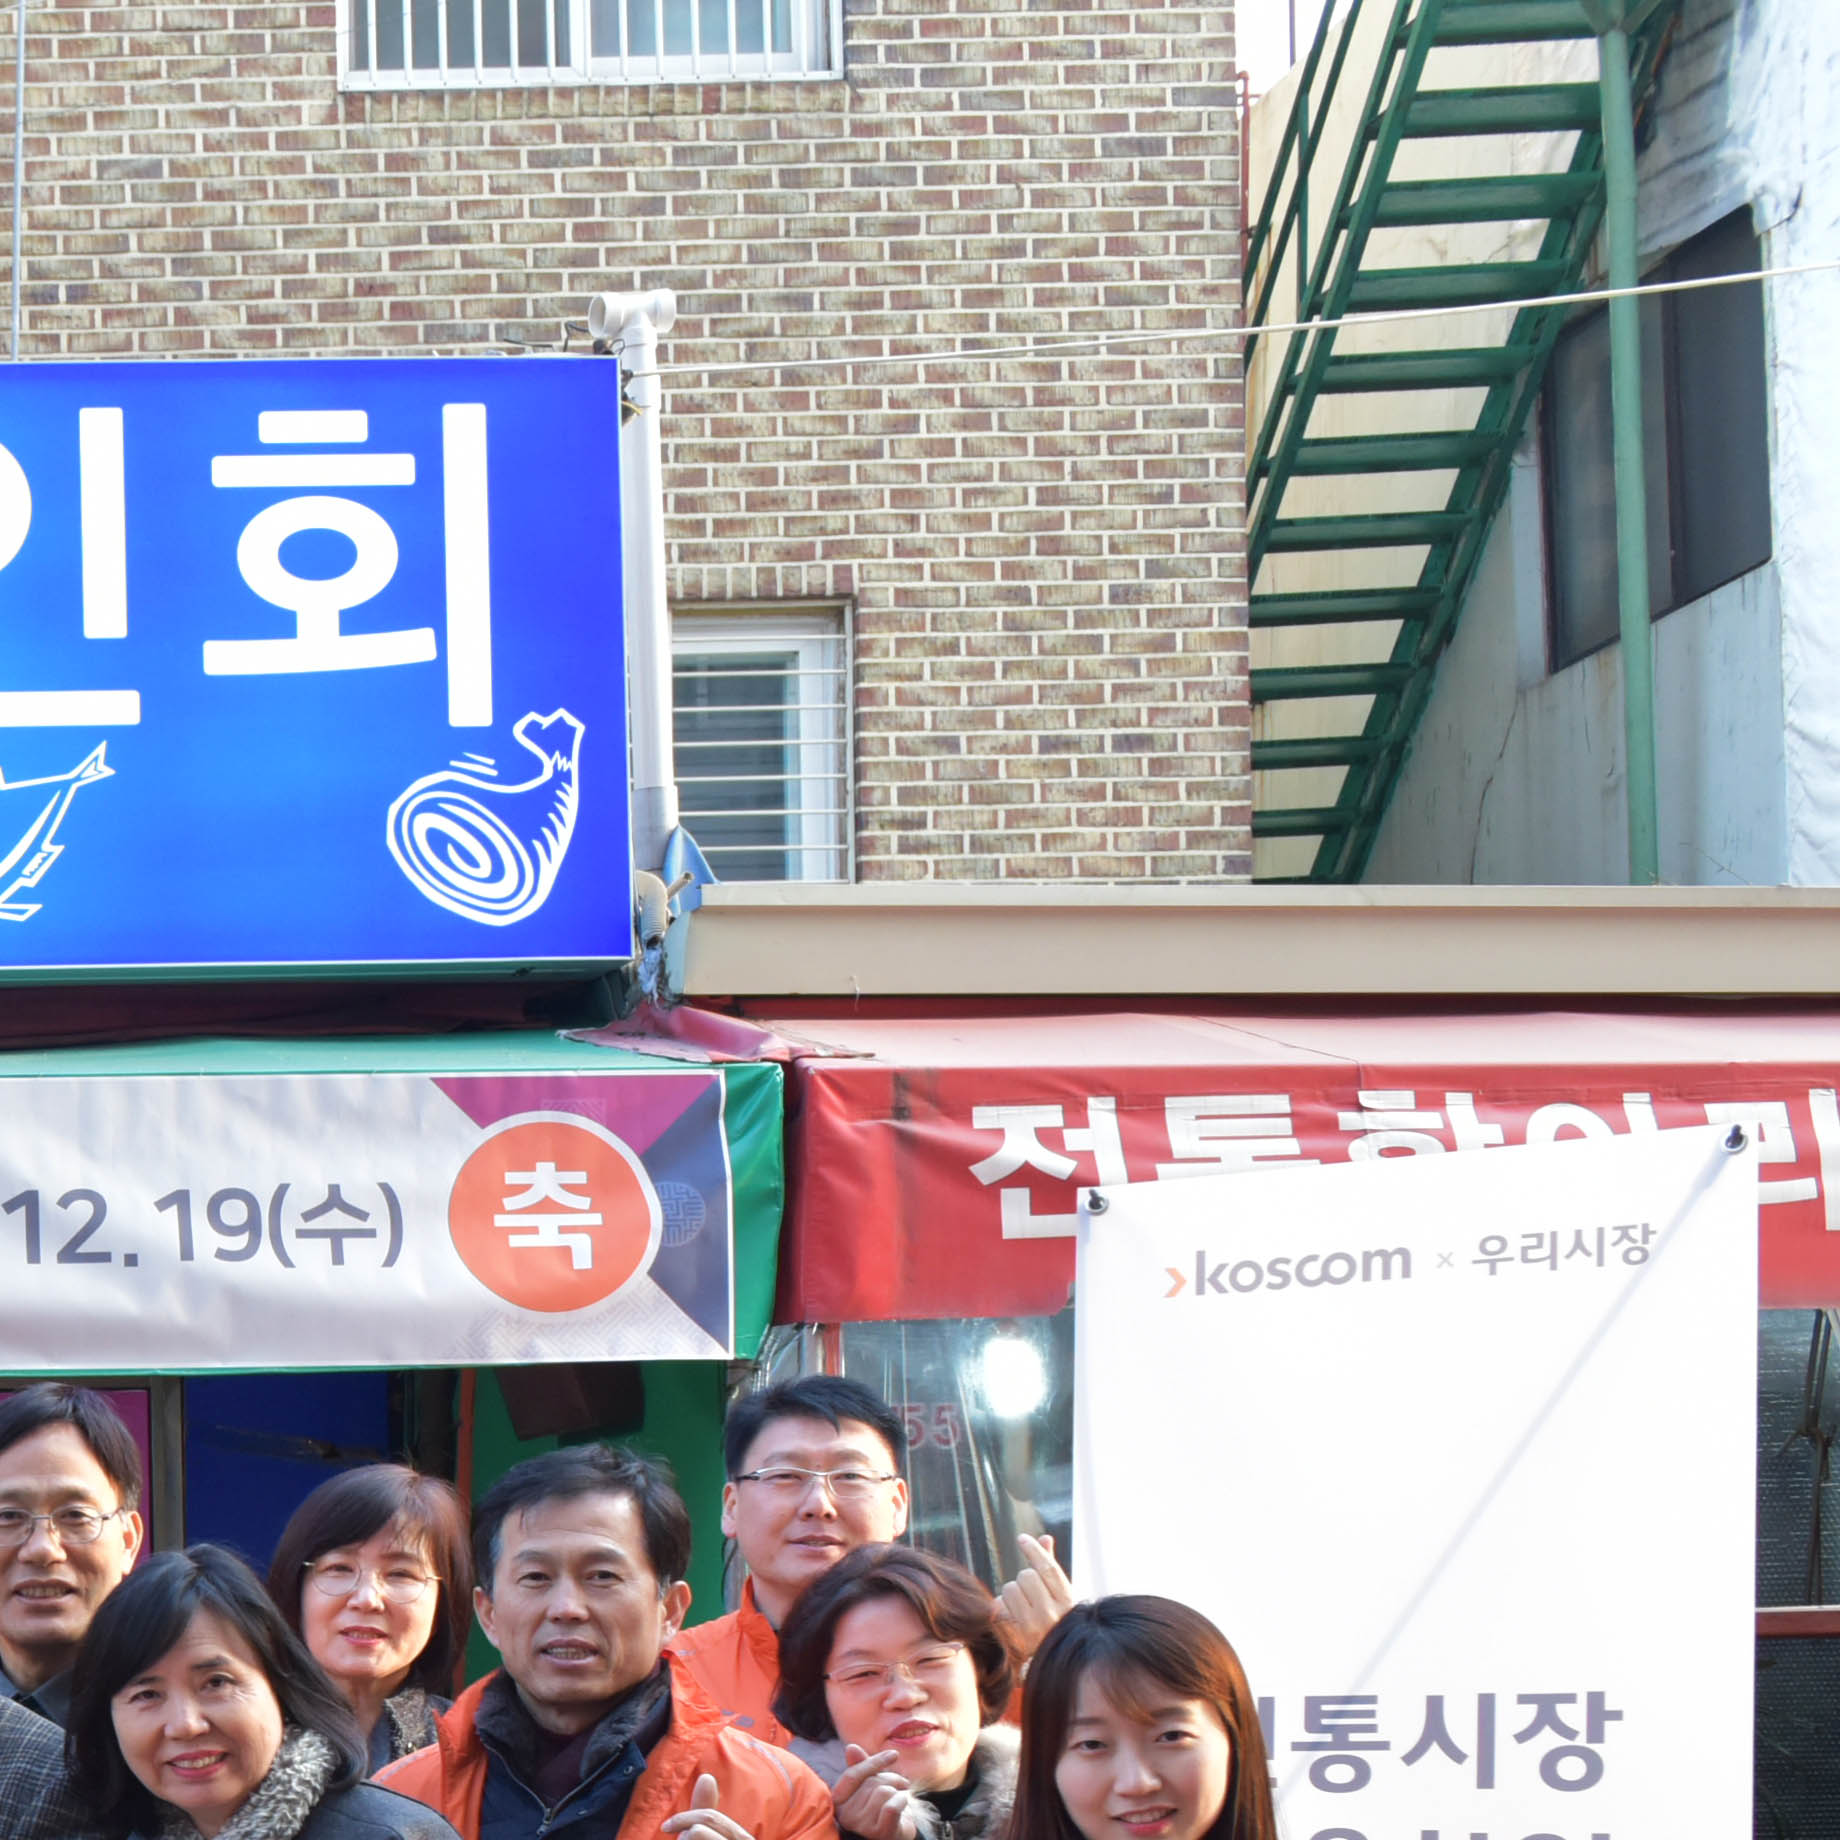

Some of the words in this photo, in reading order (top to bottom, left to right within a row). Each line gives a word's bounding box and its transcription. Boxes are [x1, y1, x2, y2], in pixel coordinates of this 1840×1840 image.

[493, 1161, 604, 1271] 축
[1194, 1240, 1412, 1297] koscom
[1471, 1222, 1657, 1277] 우리시장
[1257, 1691, 1623, 1793] 통시장
